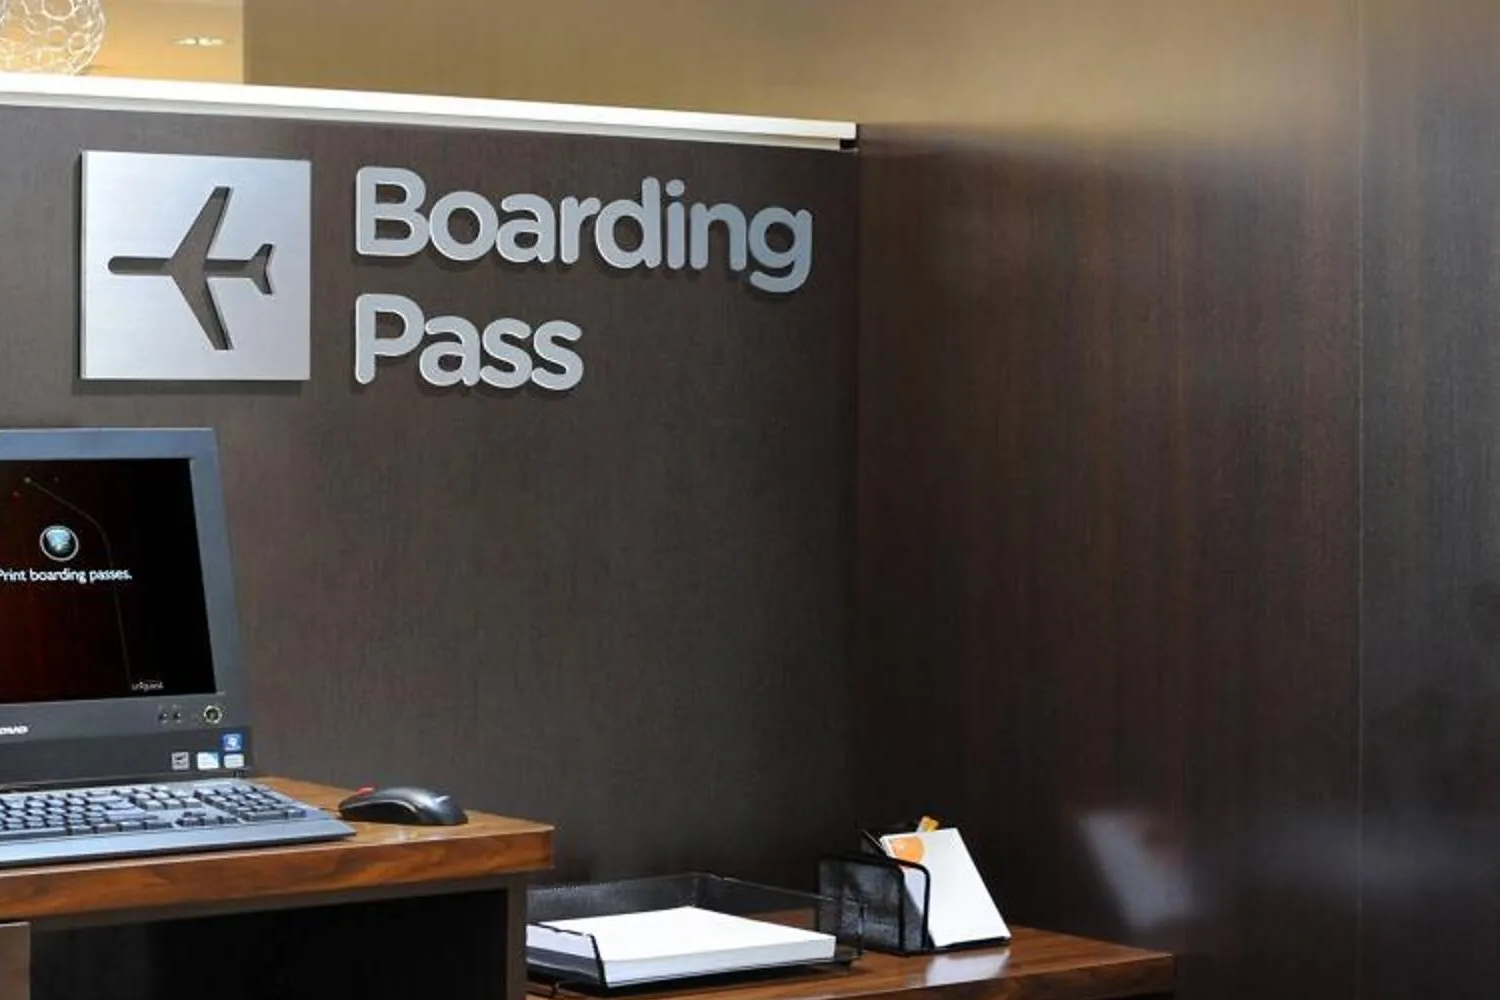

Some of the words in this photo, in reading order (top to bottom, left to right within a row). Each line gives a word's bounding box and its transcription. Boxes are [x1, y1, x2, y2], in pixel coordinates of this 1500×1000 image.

[355, 167, 812, 293] Boarding
[355, 294, 583, 390] Pass
[29, 567, 87, 584] boarding
[89, 568, 132, 583] passes.
